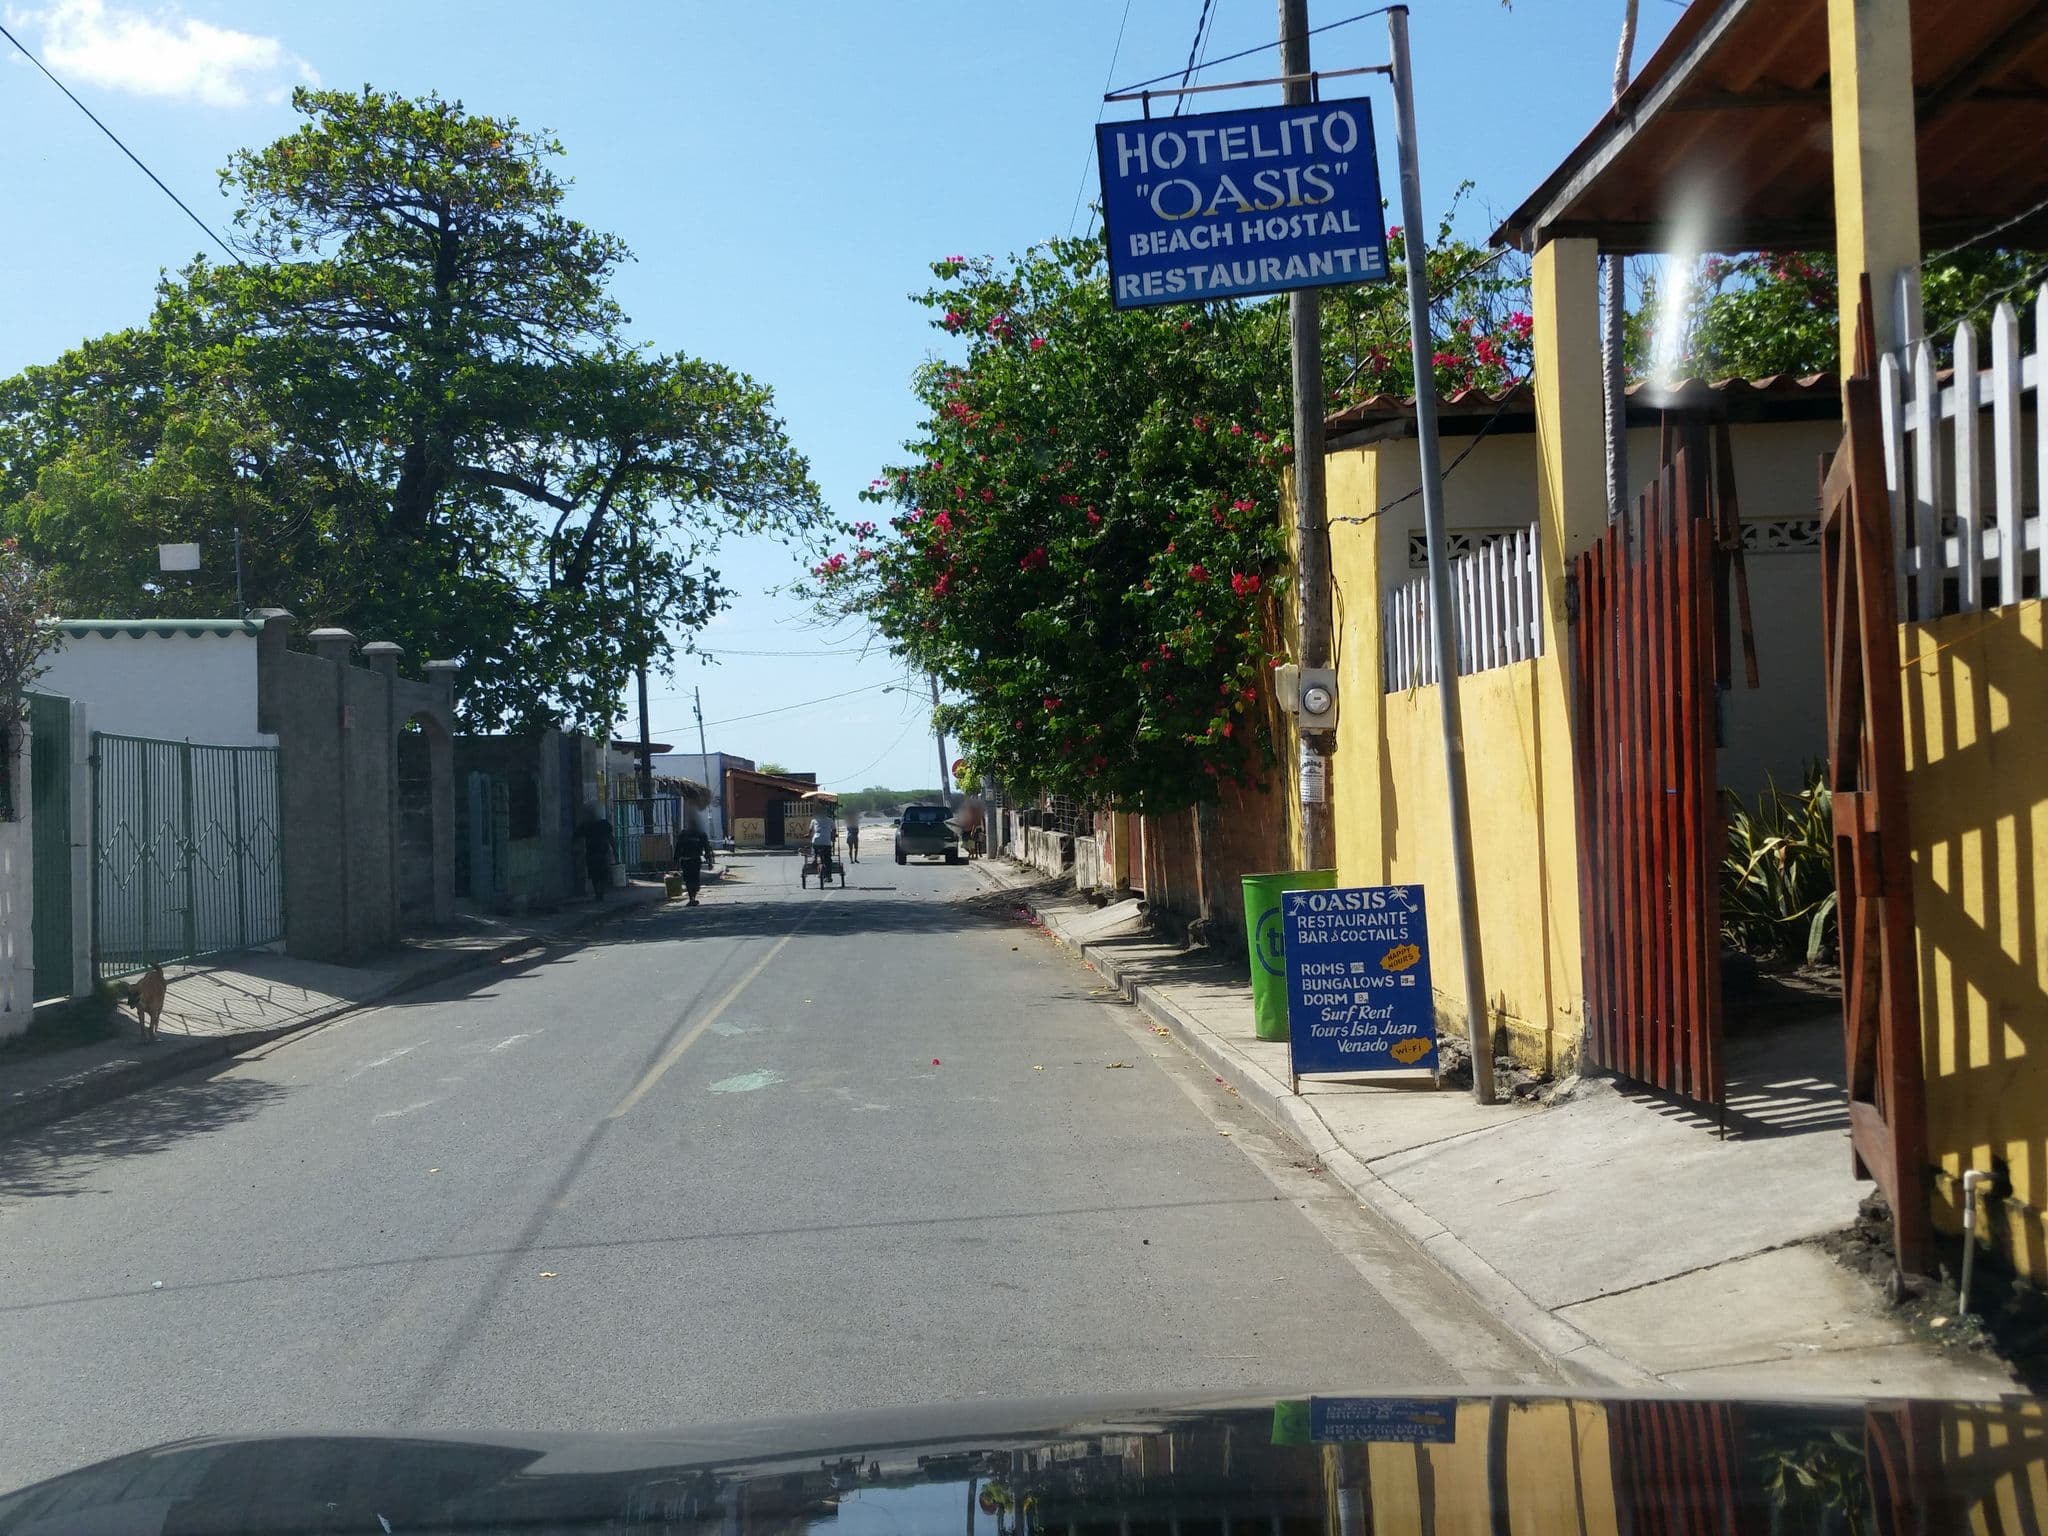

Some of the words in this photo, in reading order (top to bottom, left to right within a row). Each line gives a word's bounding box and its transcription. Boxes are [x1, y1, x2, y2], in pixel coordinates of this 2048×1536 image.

[1116, 110, 1358, 177] HOTELITO
[1136, 162, 1349, 221] "OASIS"
[1129, 222, 1234, 257] BEACH
[1241, 209, 1360, 244] HOSTAL
[1118, 246, 1382, 299] RESTAURANTE
[1309, 891, 1386, 912] OASIS
[1297, 911, 1408, 929] RESTAURANTE
[1298, 930, 1328, 944] BAR
[1340, 927, 1409, 942] COCTAILS
[1387, 947, 1411, 962] HAPPY
[1388, 953, 1414, 969] HOURS
[1301, 963, 1345, 976] ROMS
[1302, 975, 1395, 991] BUNGALOWS
[1303, 993, 1348, 1006] DORM
[1321, 1005, 1358, 1024] Surf
[1358, 1004, 1394, 1020] Rent
[1311, 1023, 1349, 1037] Tours
[1350, 1021, 1378, 1037] Isla
[1380, 1020, 1418, 1035] Juan
[1337, 1038, 1388, 1053] Venado
